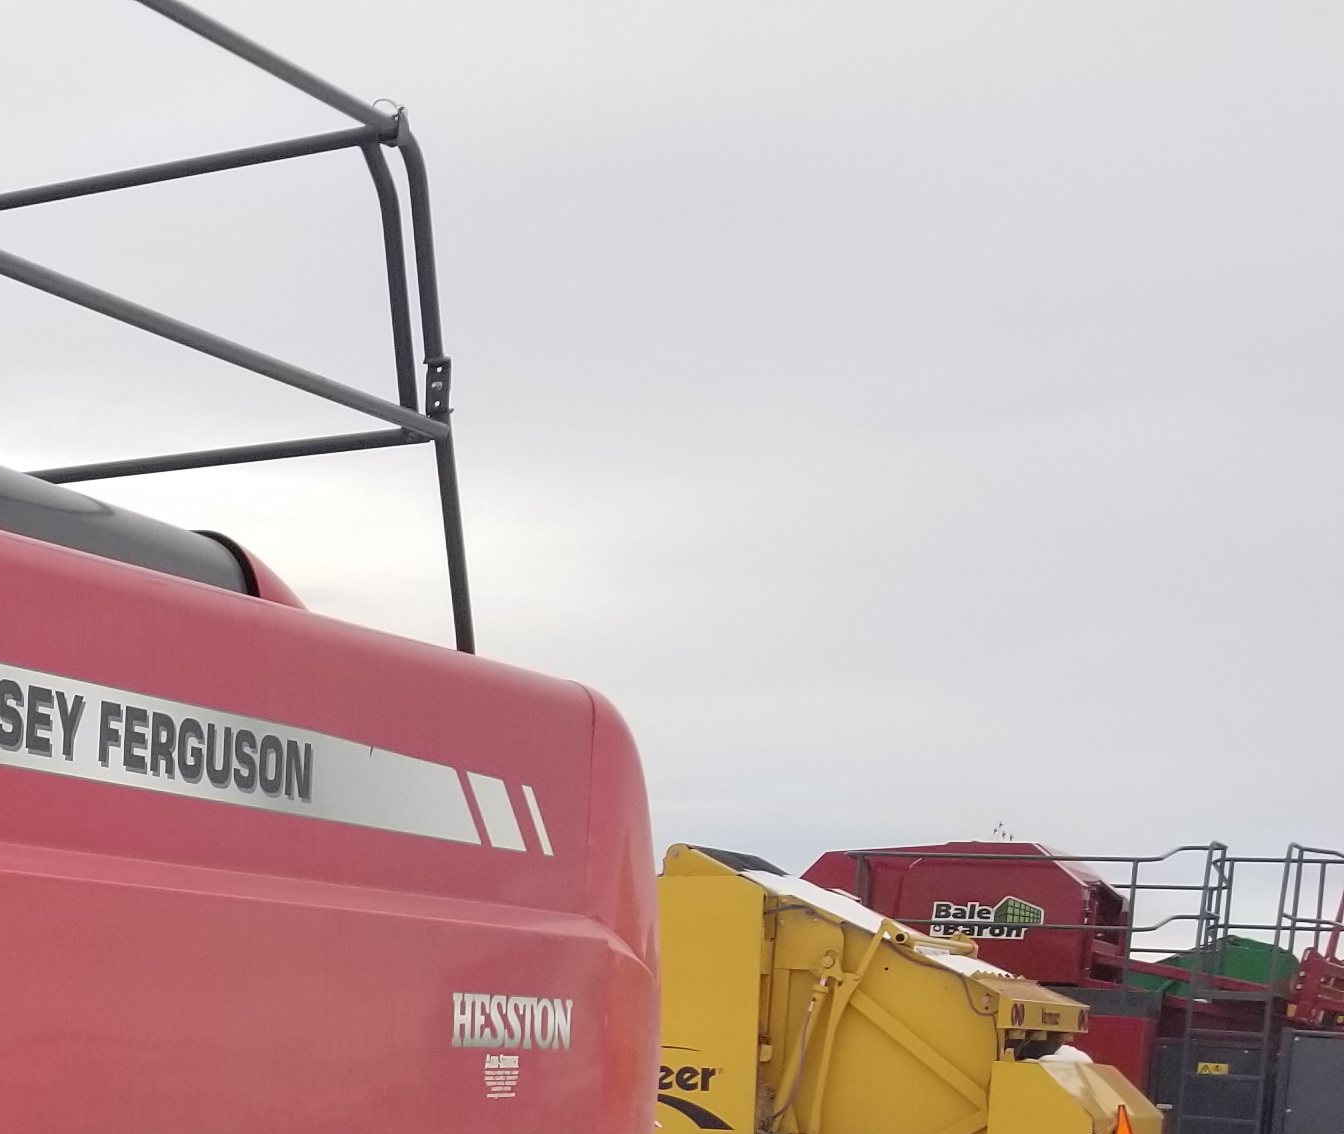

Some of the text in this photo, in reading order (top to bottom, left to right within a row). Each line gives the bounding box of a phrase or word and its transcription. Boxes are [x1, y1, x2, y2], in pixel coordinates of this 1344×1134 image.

[98, 700, 312, 803] FERGUSON
[934, 903, 992, 920] Bale
[452, 992, 574, 1050] HESSTON
